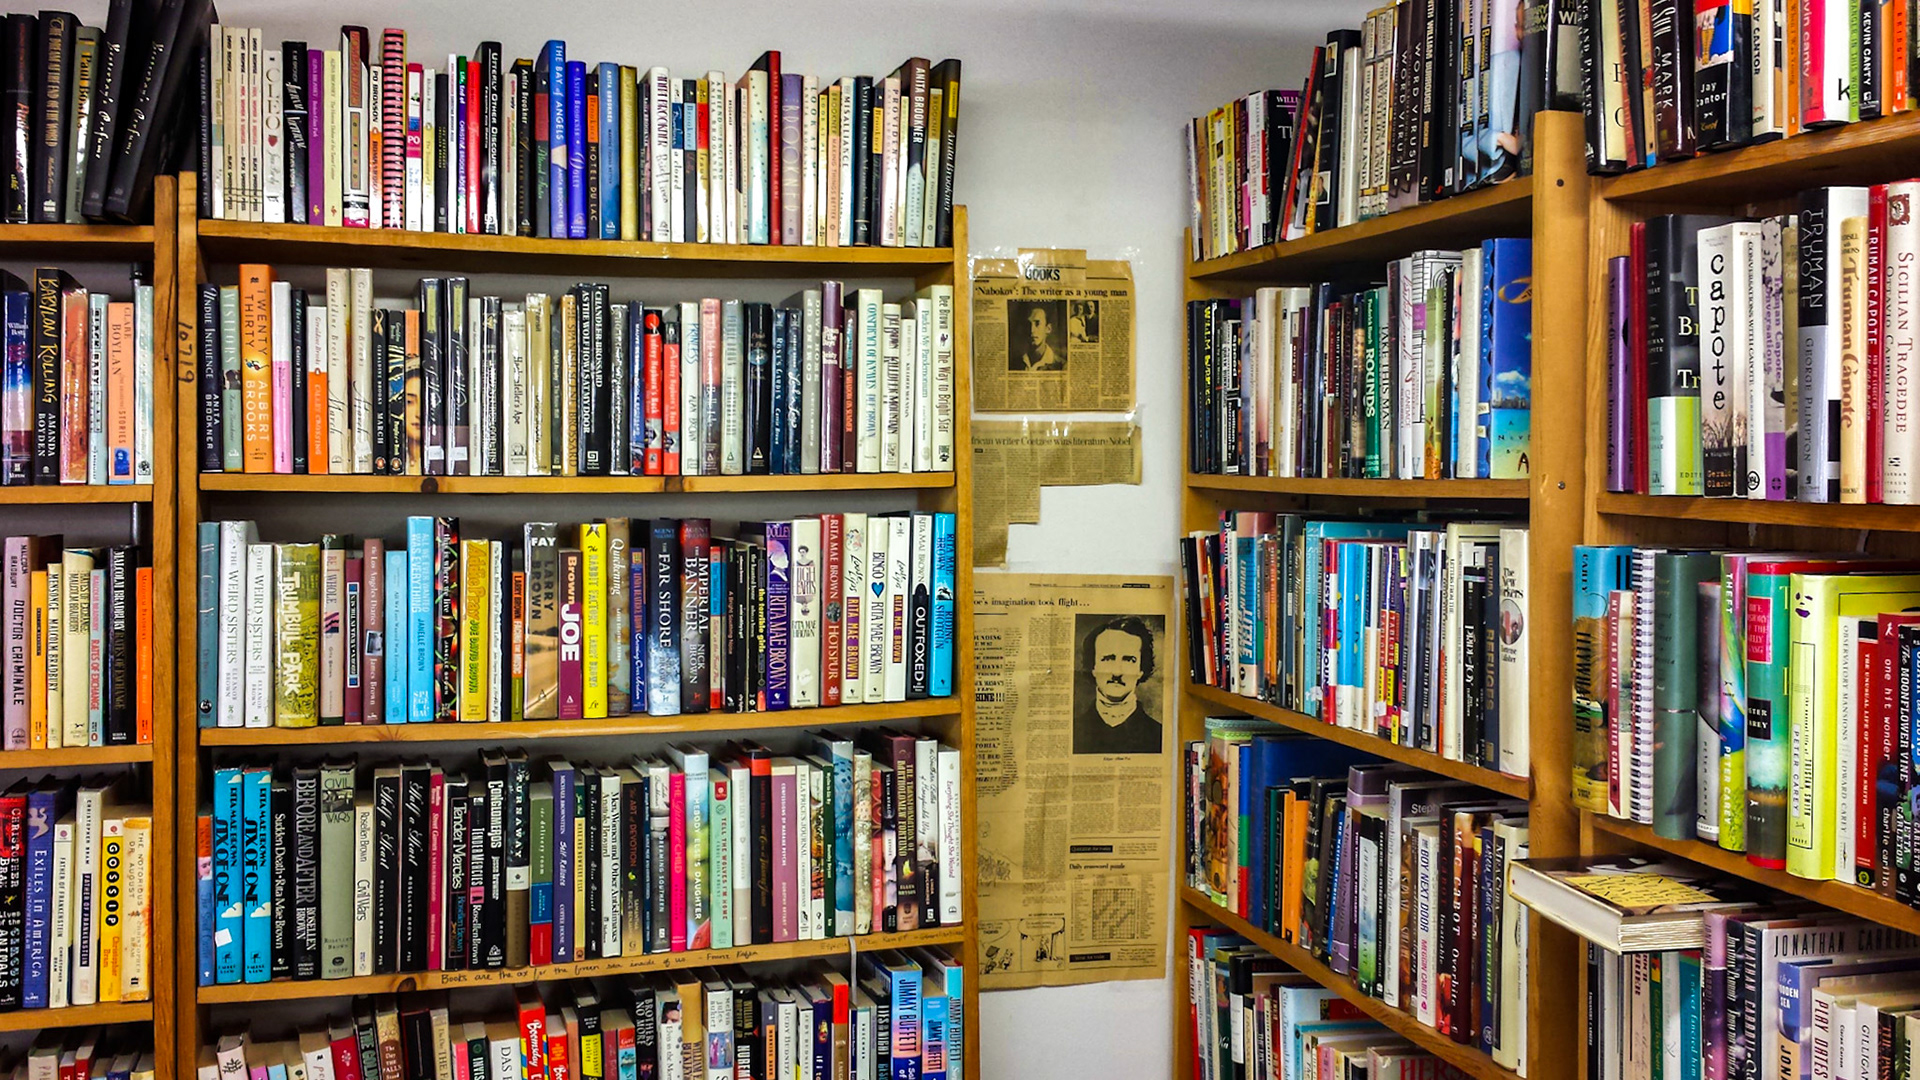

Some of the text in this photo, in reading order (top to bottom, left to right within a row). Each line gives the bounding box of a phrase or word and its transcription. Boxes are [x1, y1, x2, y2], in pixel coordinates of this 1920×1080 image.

[373, 71, 379, 81] PO
[554, 88, 564, 97] of
[556, 66, 564, 84] BAY
[1409, 42, 1421, 158] WORD VIRUS
[556, 102, 564, 140] ANGELS
[843, 96, 851, 167] MISALLIANCE
[912, 68, 926, 144] ANITA BROOKNER
[590, 187, 596, 200] DU
[245, 294, 254, 347] THIRTY
[258, 289, 268, 356] TWENTY
[922, 310, 930, 333] Pardon
[1022, 286, 1037, 296] The
[1040, 288, 1062, 296] writer
[1084, 290, 1109, 299] young
[37, 278, 59, 404] BABYLON ROLLING
[204, 288, 217, 379] UNDUE INFLUENCE
[582, 290, 590, 434] AS THE WOLF HOWLS AT MY DOOR
[595, 292, 603, 387] CHANDLER BROSSARD
[920, 335, 929, 347] My
[1710, 254, 1725, 410] capote
[1842, 257, 1859, 430] Truman Capote
[1896, 252, 1914, 433] SICILIAN TRAGEDEE
[936, 295, 950, 433] Dee Brown The Way to Bright Star
[1366, 348, 1376, 417] ROUNDS
[1382, 324, 1390, 430] TAKE THIS MAN
[247, 380, 256, 442] BROOKS
[259, 380, 270, 442] ALBERT
[376, 413, 384, 444] MARCH
[1804, 338, 1815, 462] GEORGE PLIMPTON
[38, 413, 46, 457] BOYDEN
[48, 413, 56, 456] AMANDA
[371, 556, 379, 569] Los
[530, 537, 557, 547] FAY
[610, 538, 626, 597] Quickening
[830, 520, 839, 599] RITA MAE BROWN
[253, 575, 264, 614] WEIRD
[369, 571, 379, 598] Angeles
[412, 534, 422, 614] WAS EVERYTHING
[443, 534, 452, 614] this is where we live
[532, 562, 541, 620] BROWN
[545, 561, 554, 612] LARRY
[567, 556, 578, 605] Brown
[658, 554, 672, 649] FAR SHORE
[684, 558, 698, 633] BANNER
[698, 558, 709, 634] IMPERIAL
[992, 598, 1036, 609] imagination
[1038, 598, 1055, 606] took
[252, 617, 264, 661] SISTERS
[281, 572, 303, 696] TRUMBULL PARK
[371, 600, 379, 626] Diaries
[561, 603, 580, 662] JOE
[12, 600, 25, 706] DOCTOR CRIMINALE
[417, 619, 426, 672] JANELLE BROWN
[689, 645, 699, 685] BROWN
[696, 644, 706, 670] NICK
[829, 625, 840, 680] HOTSPUR
[914, 607, 926, 682] OUTFOXED
[371, 658, 379, 706] James Brown
[1882, 688, 1891, 709] hit
[1882, 717, 1891, 761] wonder
[1900, 645, 1911, 783] The MOONFLOWER VINE
[488, 780, 504, 848] CONGLOMEROS
[515, 775, 523, 858] TURNAWAY
[1723, 786, 1731, 825] CAREY
[216, 817, 230, 907] SIX OF ONE
[296, 779, 316, 904] BEFORE AND AFTER
[452, 802, 467, 890] Tender Mercies
[107, 842, 120, 927] GOSSIP
[275, 814, 286, 949] Sudden Death Rita Mae Brown
[356, 880, 370, 922] Civil Wars
[1420, 850, 1430, 932] BOY NEXT DOOR
[1774, 932, 1845, 958] JONATHAN
[526, 1020, 542, 1067] Boomsday
[899, 979, 917, 1052] JIMMY BUFFETT
[500, 1046, 512, 1072] DAS
